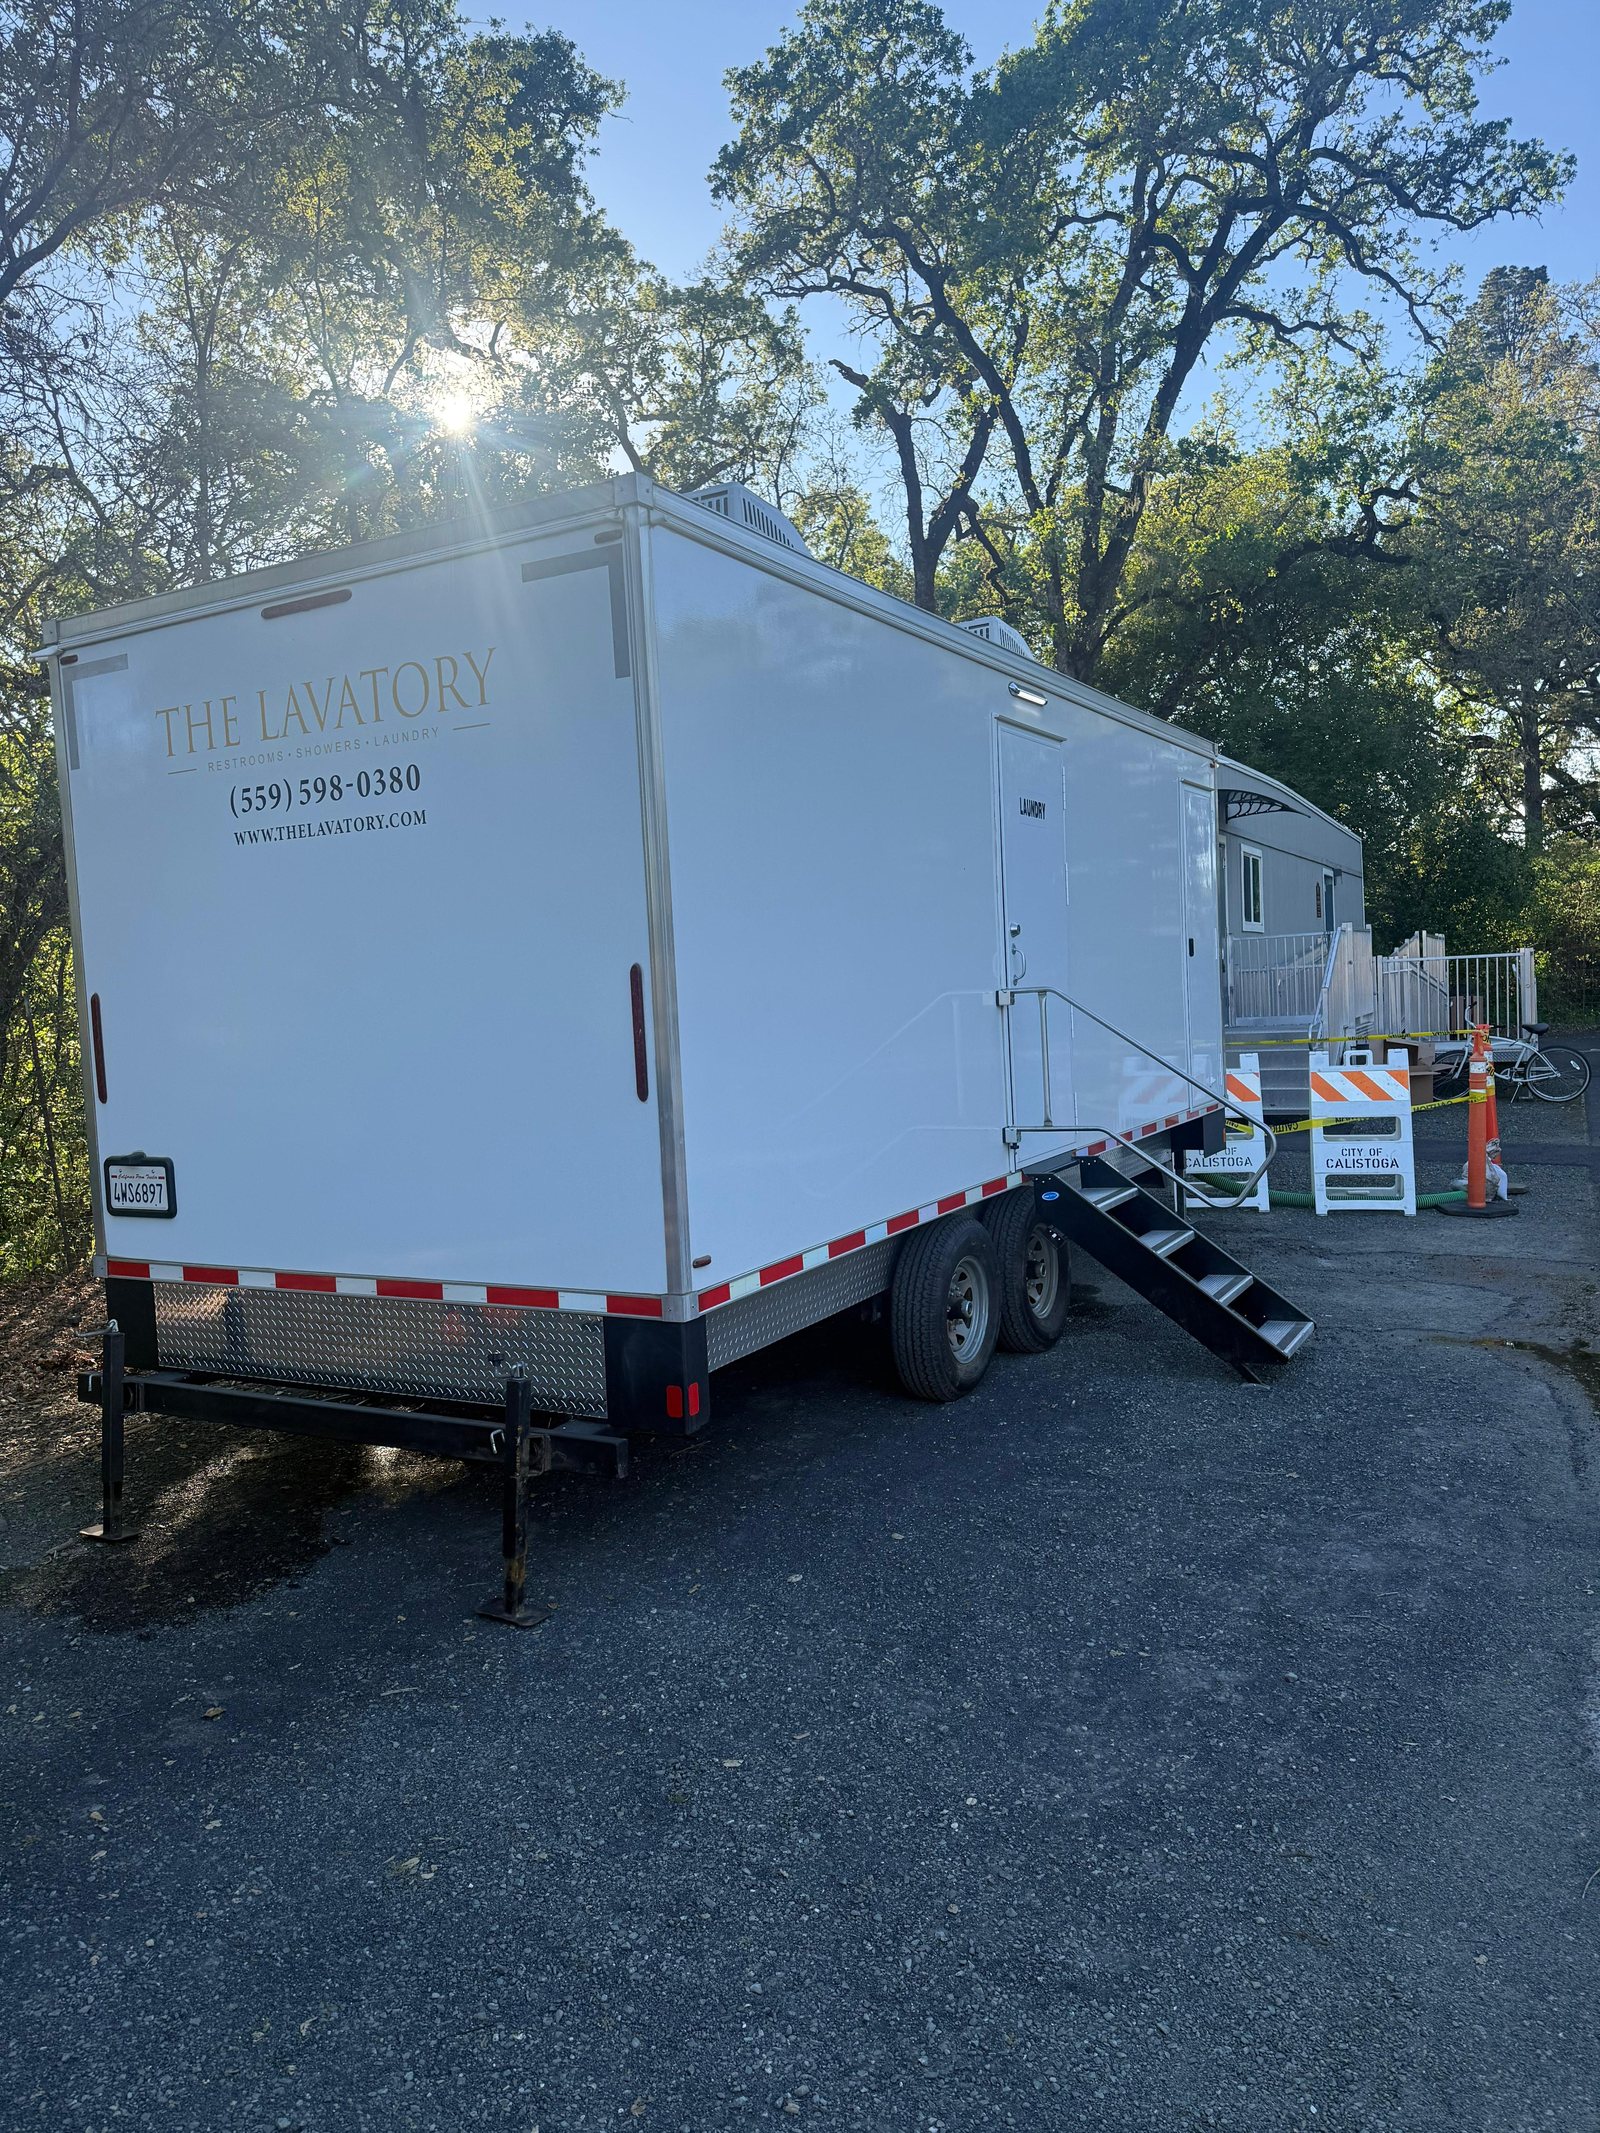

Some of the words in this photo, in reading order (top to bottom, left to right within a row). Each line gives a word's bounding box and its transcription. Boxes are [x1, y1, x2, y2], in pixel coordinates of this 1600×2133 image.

[155, 696, 242, 758] THE
[256, 647, 497, 742] LAVATORY
[207, 750, 285, 773] RESTROOMS
[296, 739, 362, 759] SHOWERS
[374, 726, 440, 747] LAUNDRY
[230, 778, 293, 819] (559)
[299, 764, 421, 806] 598-0380
[1019, 797, 1046, 820] LAUNDRY
[233, 809, 428, 846] WWW.THELAVATORY.COM
[1326, 1158, 1400, 1169] CALISTOGA
[1341, 1148, 1363, 1157] CITY
[1369, 1147, 1383, 1157] OF
[114, 1182, 163, 1204] 4WS6897
